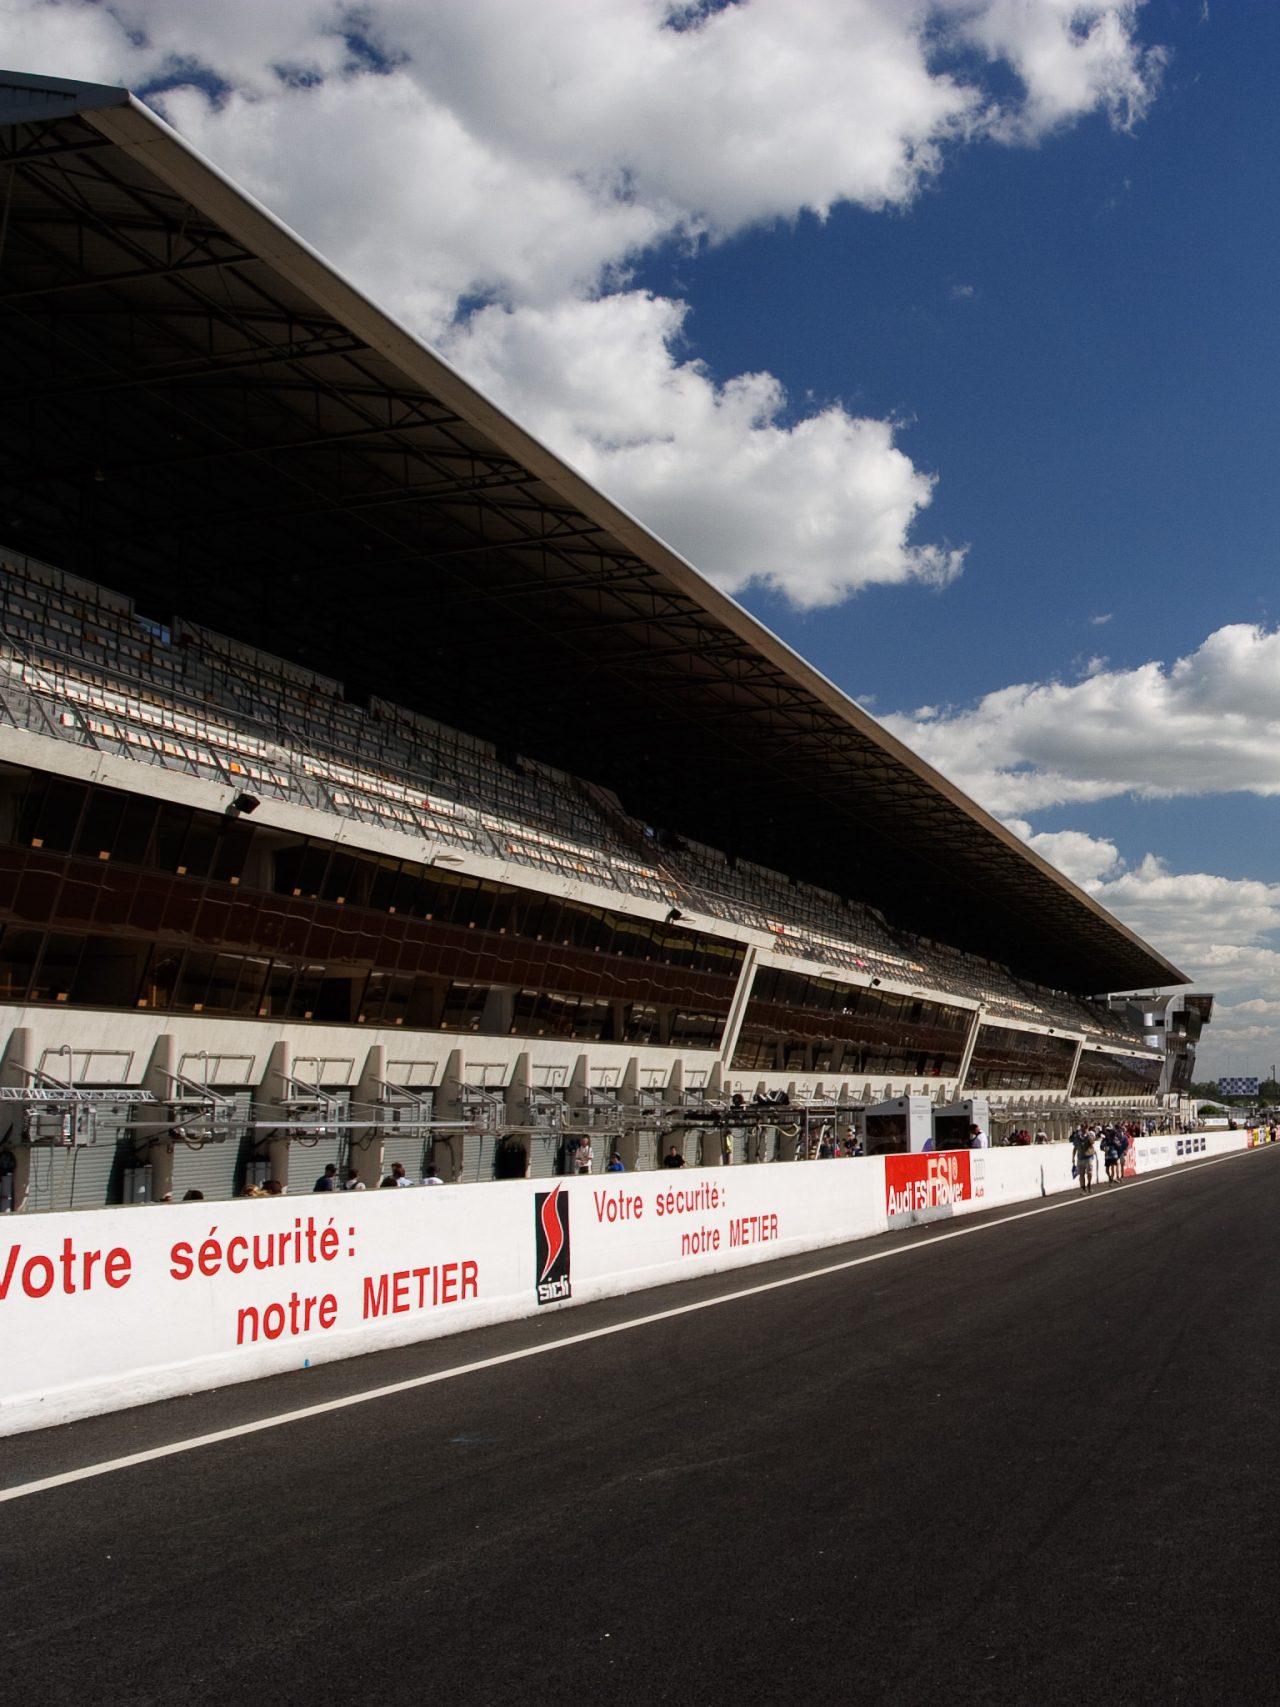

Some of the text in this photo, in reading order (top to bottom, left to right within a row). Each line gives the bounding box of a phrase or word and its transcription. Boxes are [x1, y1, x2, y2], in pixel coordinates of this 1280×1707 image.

[594, 1182, 727, 1223] Votre sécurité:
[887, 1181, 913, 1217] Audi
[170, 1216, 355, 1281] sécurité:
[682, 1213, 779, 1257] notre METIER
[236, 1260, 479, 1345] notre METIER
